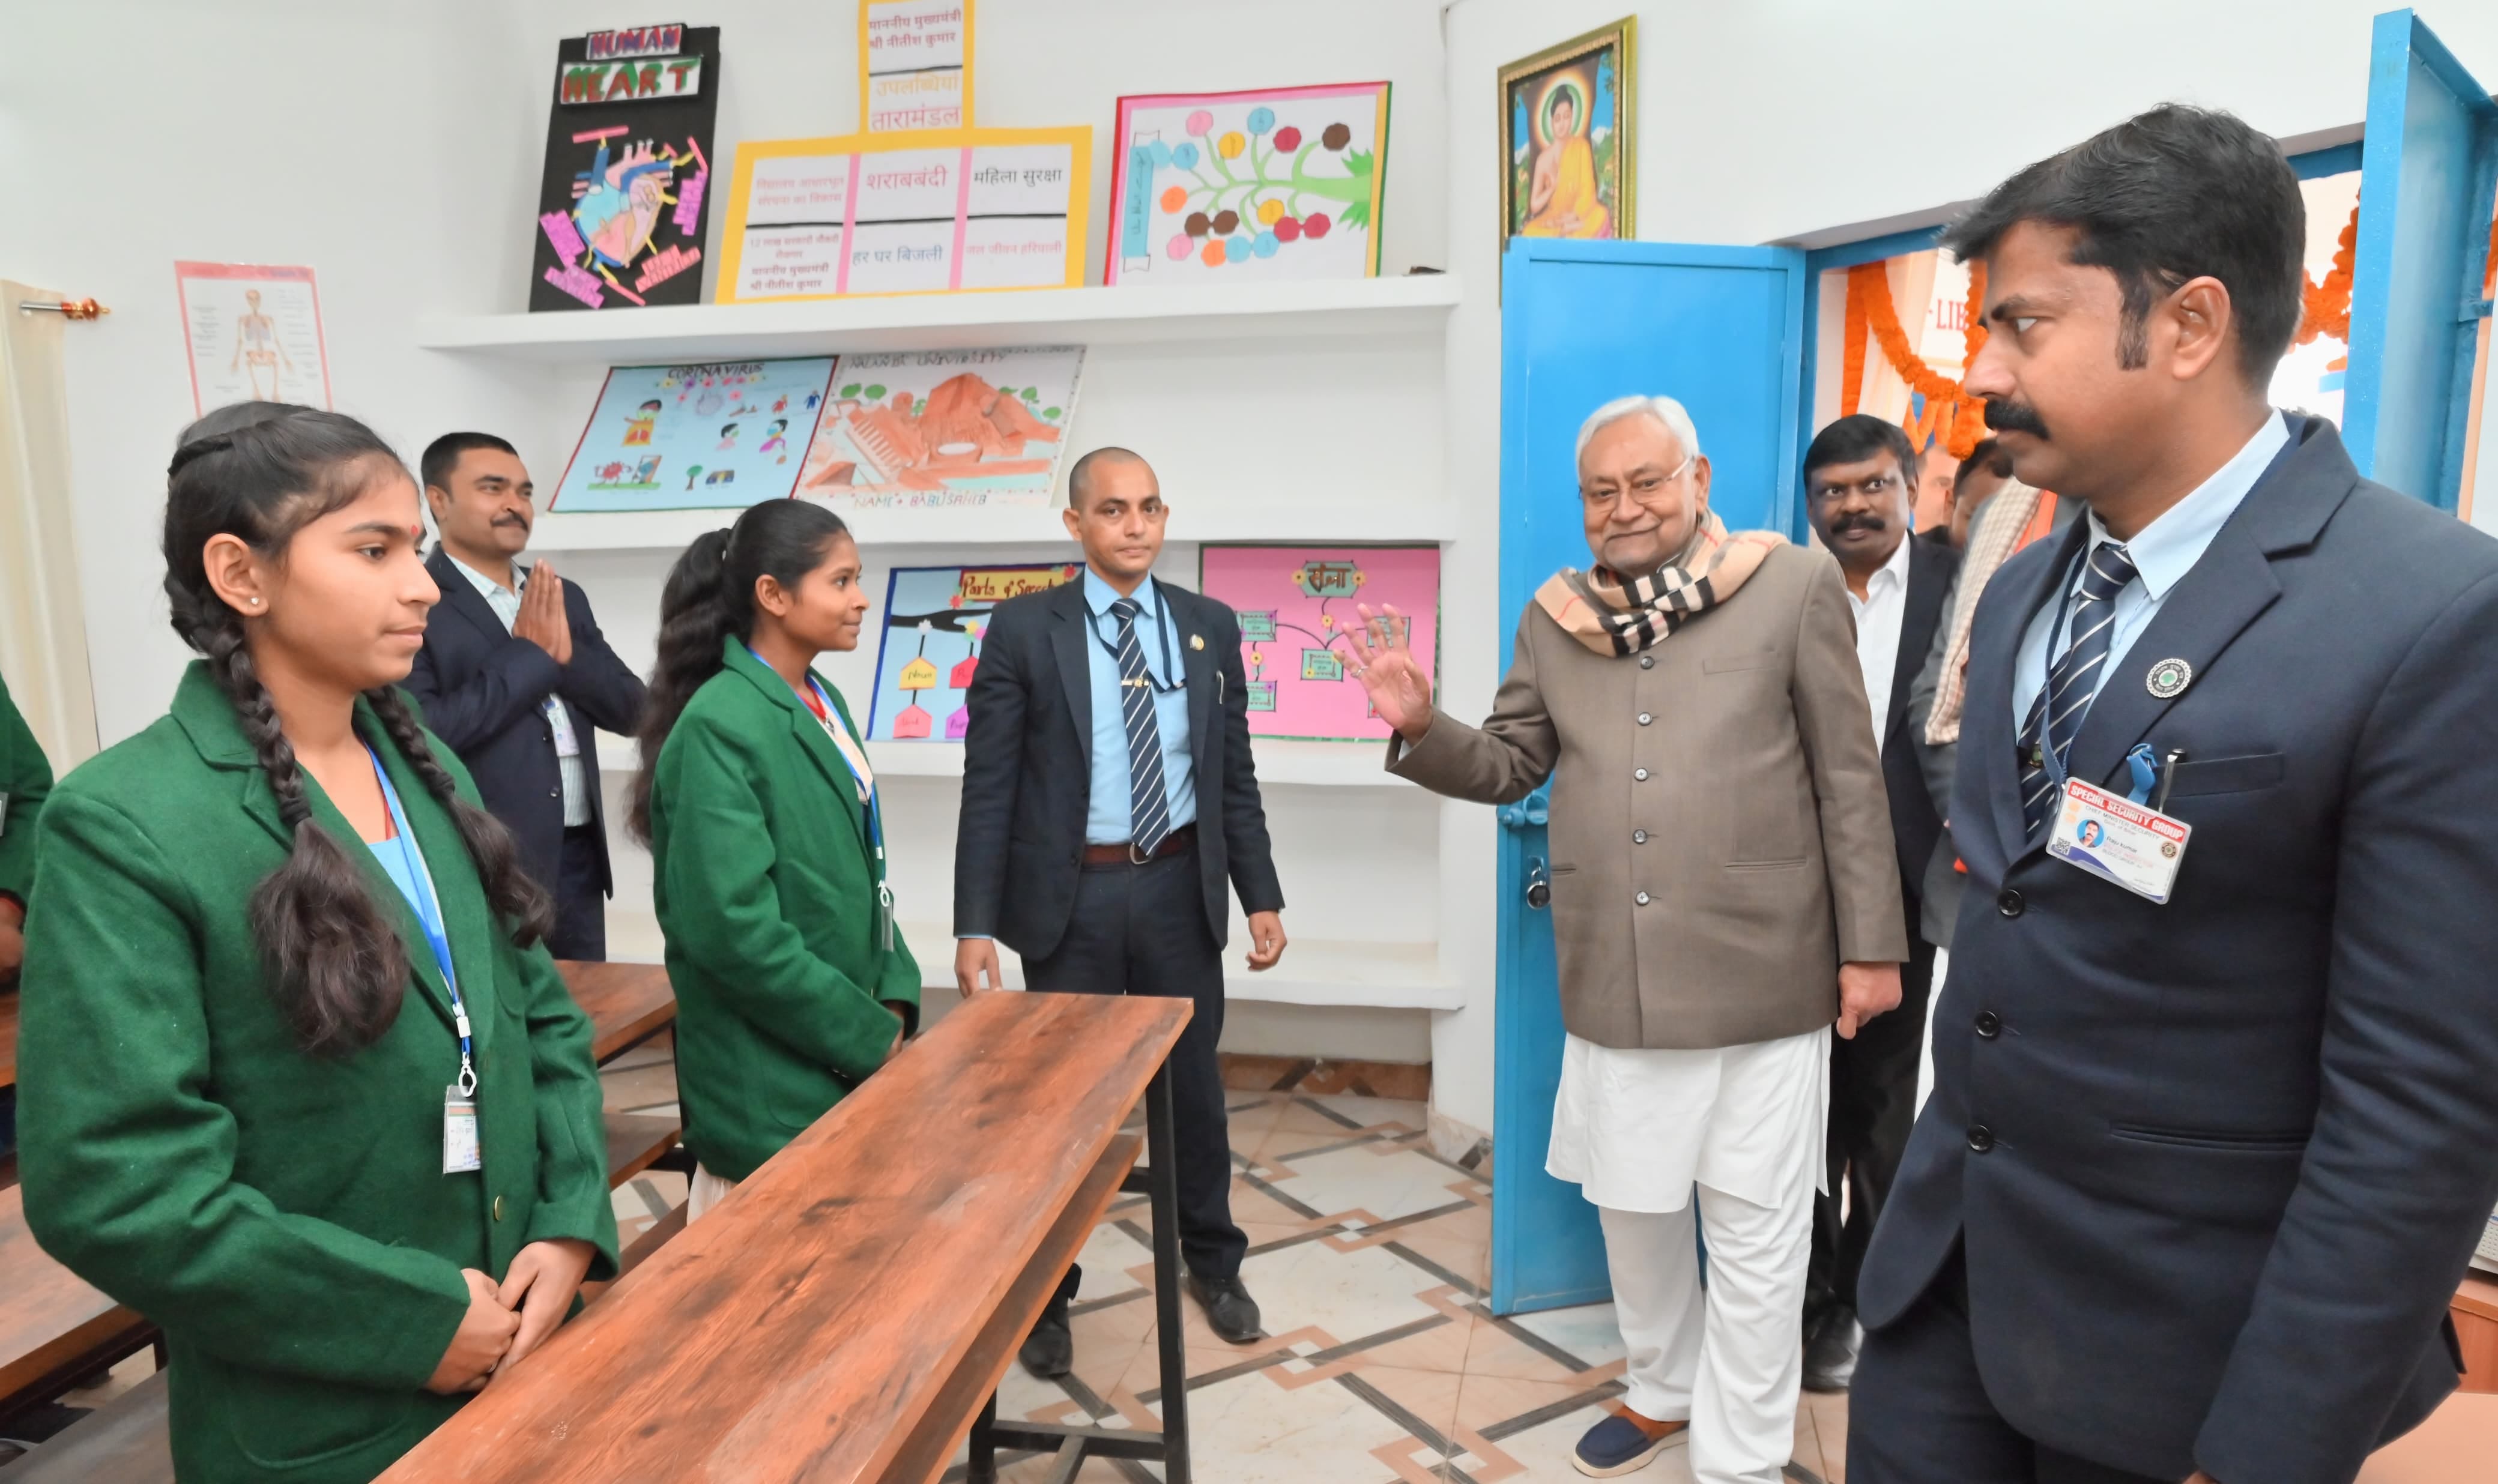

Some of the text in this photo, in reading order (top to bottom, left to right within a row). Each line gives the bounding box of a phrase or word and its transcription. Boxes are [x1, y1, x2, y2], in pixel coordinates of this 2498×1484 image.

[869, 15, 910, 29] माननीय
[590, 25, 680, 57] HUMAN
[925, 32, 956, 47] कुमार
[563, 59, 699, 102] HEART
[872, 103, 962, 131] तारामंडल
[866, 164, 949, 190] शराबबंदी
[974, 167, 1063, 188] महिला सुरक्षा
[897, 245, 942, 263] बिजली
[963, 575, 995, 598] Parts
[2070, 785, 2184, 839] SPECIAL SECURITY GROUP
[2102, 812, 2131, 828] MINISTER
